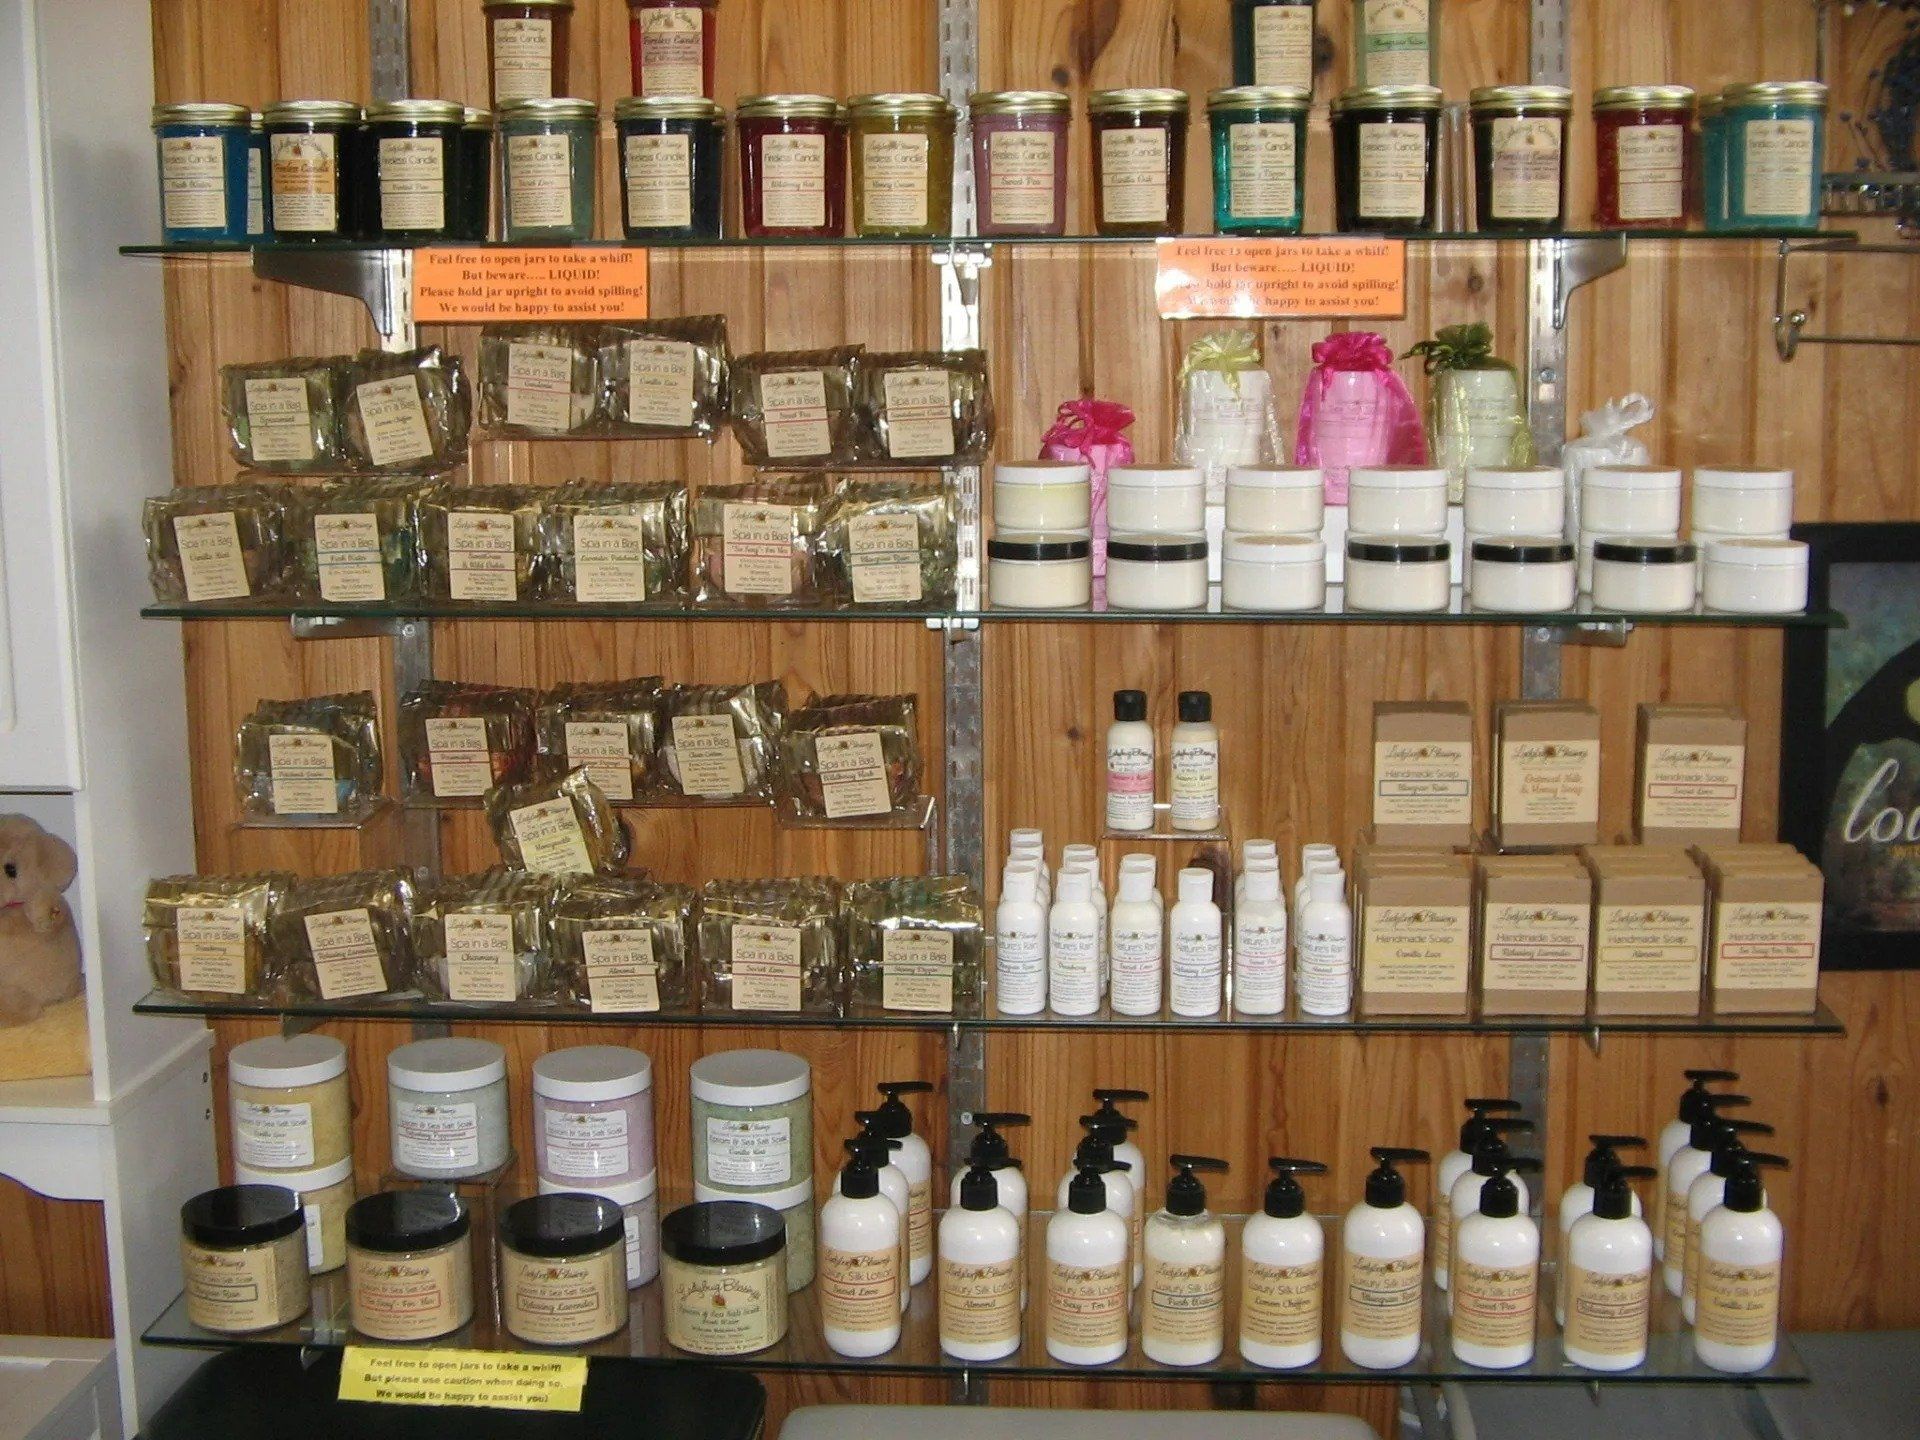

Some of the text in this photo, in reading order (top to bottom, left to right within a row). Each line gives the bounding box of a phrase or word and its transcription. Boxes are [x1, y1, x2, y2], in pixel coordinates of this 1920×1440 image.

[429, 253, 453, 264] Feel
[455, 253, 477, 264] free
[480, 255, 490, 263] to
[493, 255, 521, 266] open
[523, 252, 546, 266] jars
[562, 252, 587, 264] take
[1176, 245, 1201, 256] Feel
[1203, 245, 1226, 256] free
[1243, 247, 1272, 259] open
[1274, 245, 1299, 258] jars
[1302, 248, 1312, 256] to
[1315, 245, 1341, 256] take
[461, 269, 482, 280] But
[548, 269, 600, 281] LIQUID!
[1210, 261, 1231, 273] But
[1300, 261, 1355, 275] LIQUID!
[419, 286, 455, 297] Please
[457, 285, 483, 297] hold
[485, 286, 502, 299] jar
[505, 285, 547, 299] upright
[564, 285, 595, 296] avoid
[597, 284, 643, 298] spilling!
[1205, 278, 1232, 289] hold
[1255, 278, 1299, 292] upright
[1317, 279, 1349, 289] avoid
[1351, 278, 1399, 292] spilling!
[439, 301, 624, 315] We would be happy to assist you!
[1264, 295, 1299, 309] happy
[1318, 295, 1350, 306] assist
[1352, 295, 1379, 308] you!
[369, 1357, 393, 1367] Feel
[394, 1359, 416, 1368] free
[431, 1361, 457, 1371] open
[458, 1361, 480, 1372] jars
[495, 1362, 520, 1372] take
[363, 1372, 383, 1383] But
[383, 1374, 419, 1386] please
[421, 1376, 441, 1385] use
[443, 1375, 483, 1386] caution
[484, 1377, 513, 1386] when
[515, 1378, 545, 1389] doing
[376, 1390, 392, 1398] We
[394, 1390, 427, 1400] would
[443, 1391, 475, 1402] happy
[491, 1392, 523, 1401] assist
